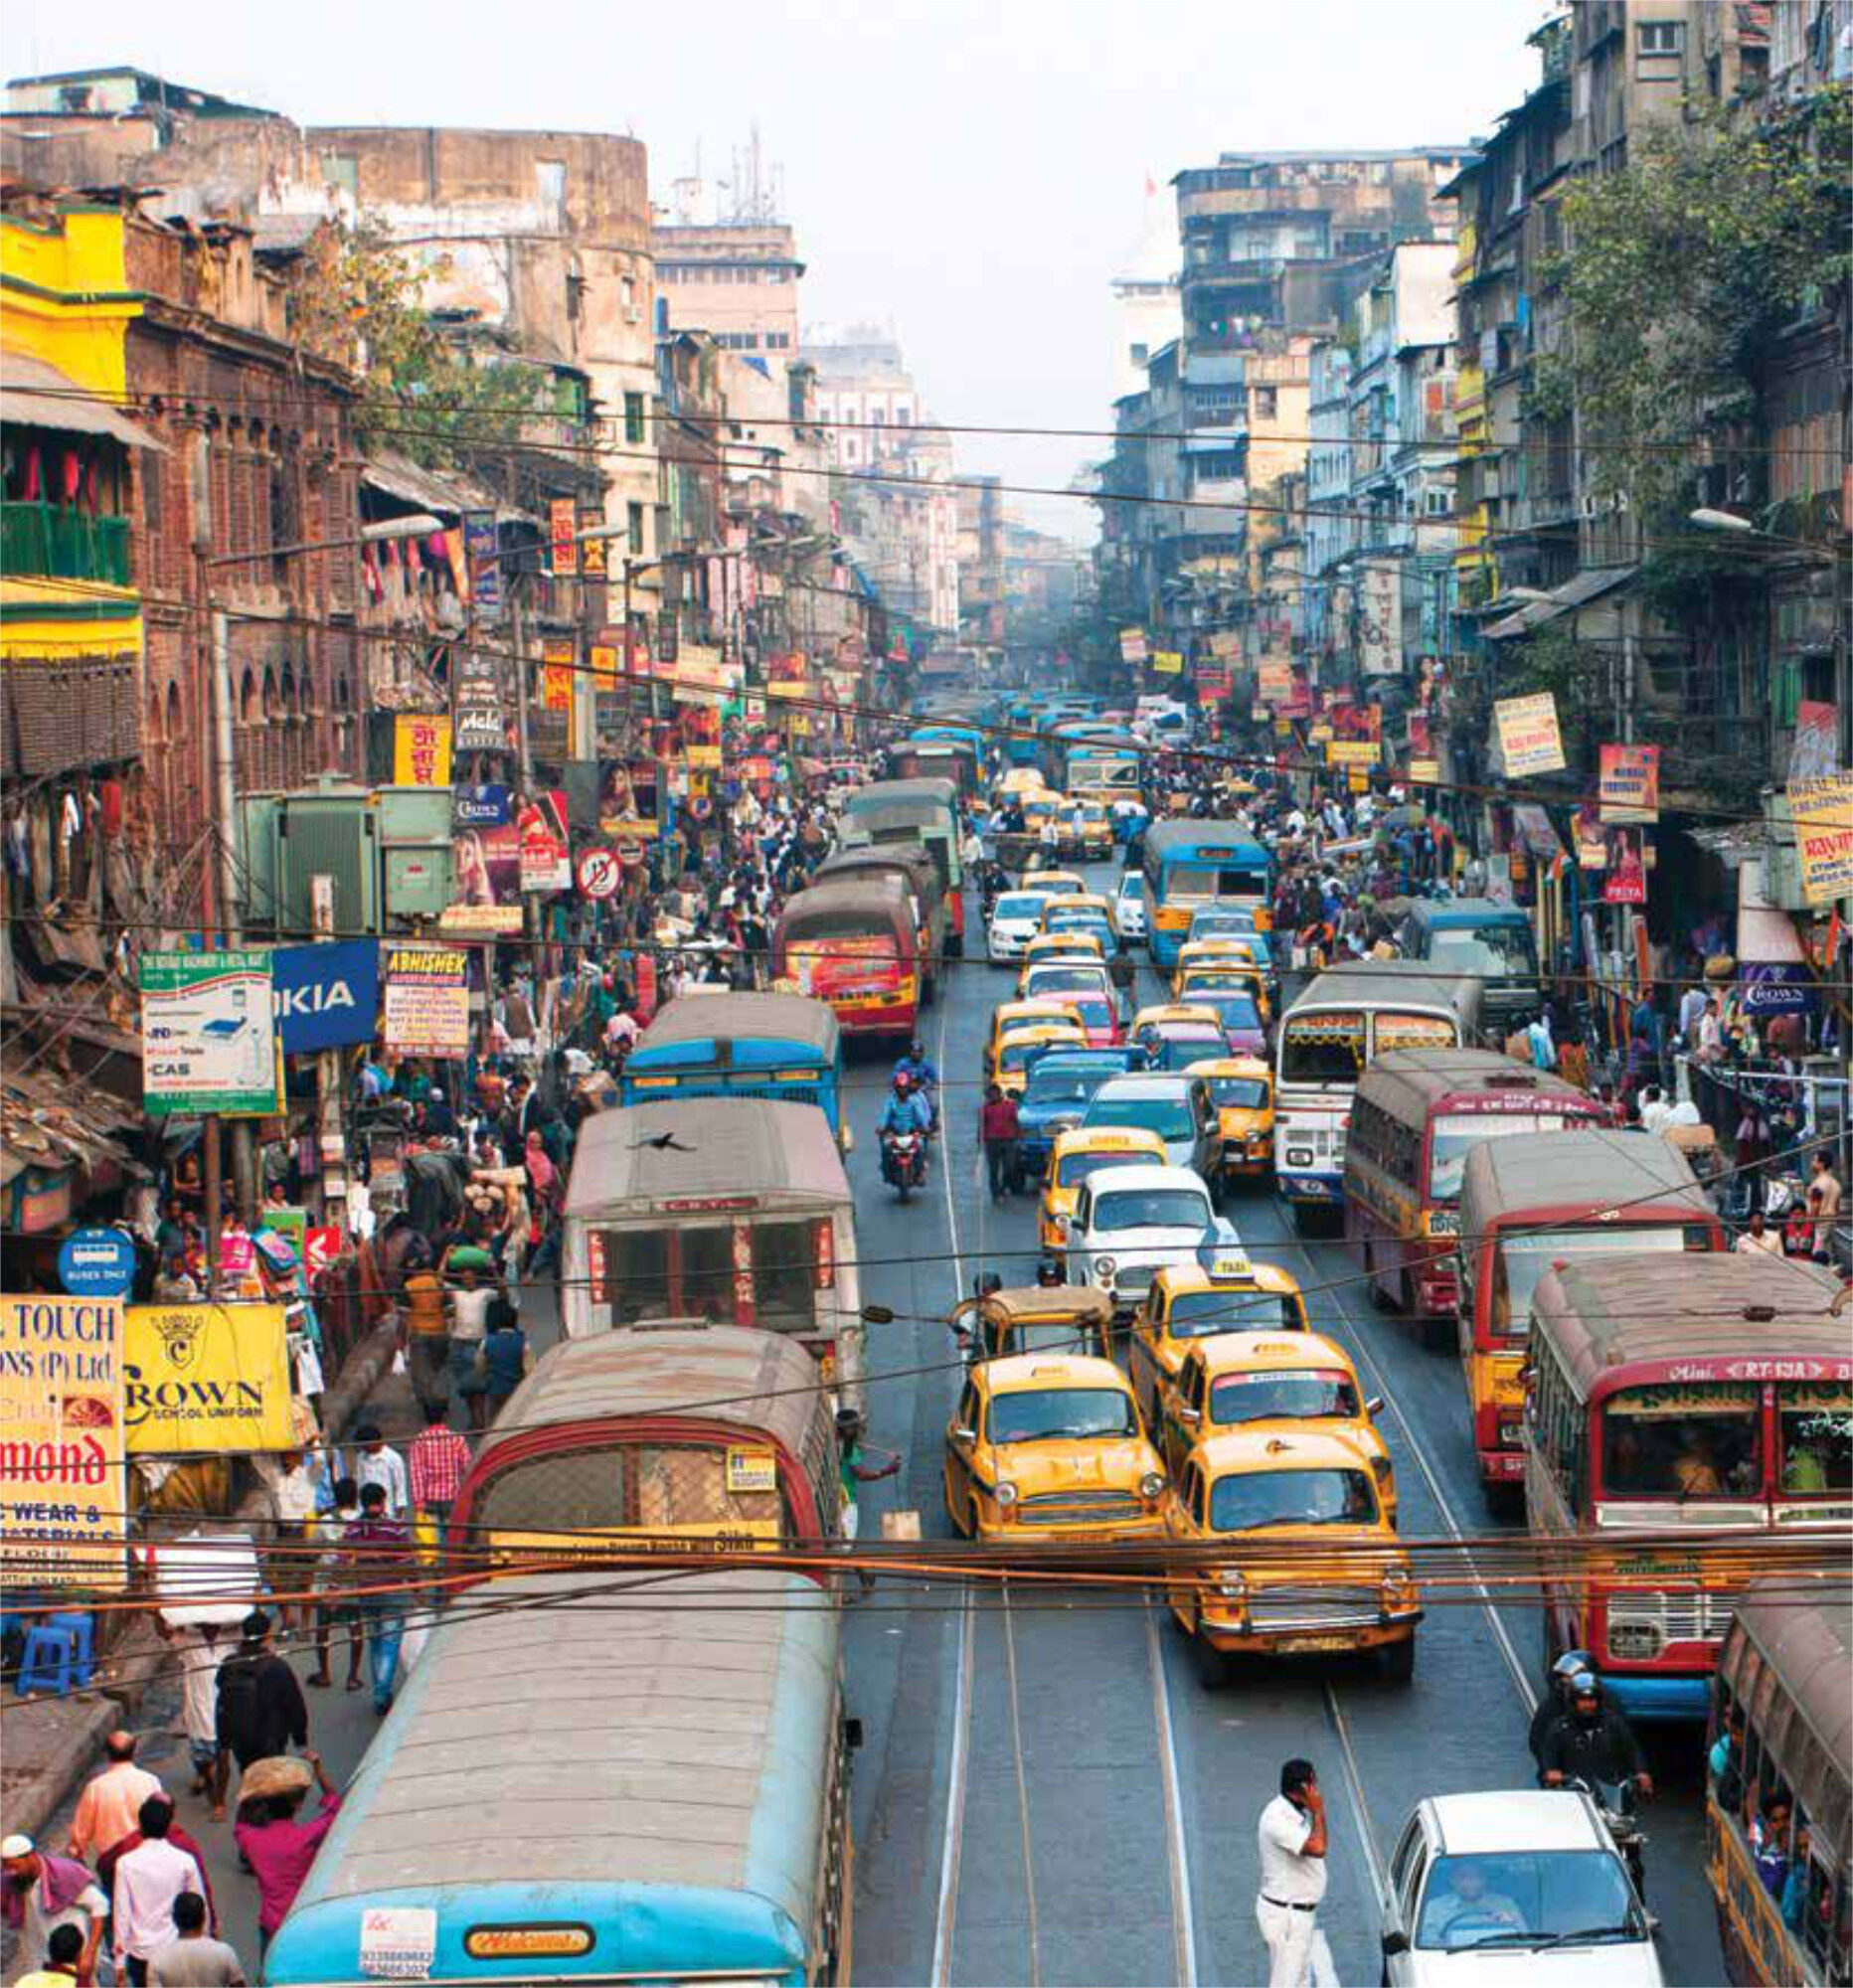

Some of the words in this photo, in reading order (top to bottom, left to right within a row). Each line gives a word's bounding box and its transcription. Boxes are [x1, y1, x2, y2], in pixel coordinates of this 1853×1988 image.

[389, 949, 467, 973] ABHISHEK
[14, 1304, 115, 1342] TOUCH
[153, 1408, 204, 1419] SCHOOL
[207, 1407, 262, 1417] UNIFORM
[14, 1503, 78, 1522] WEAR
[86, 1505, 100, 1524] &
